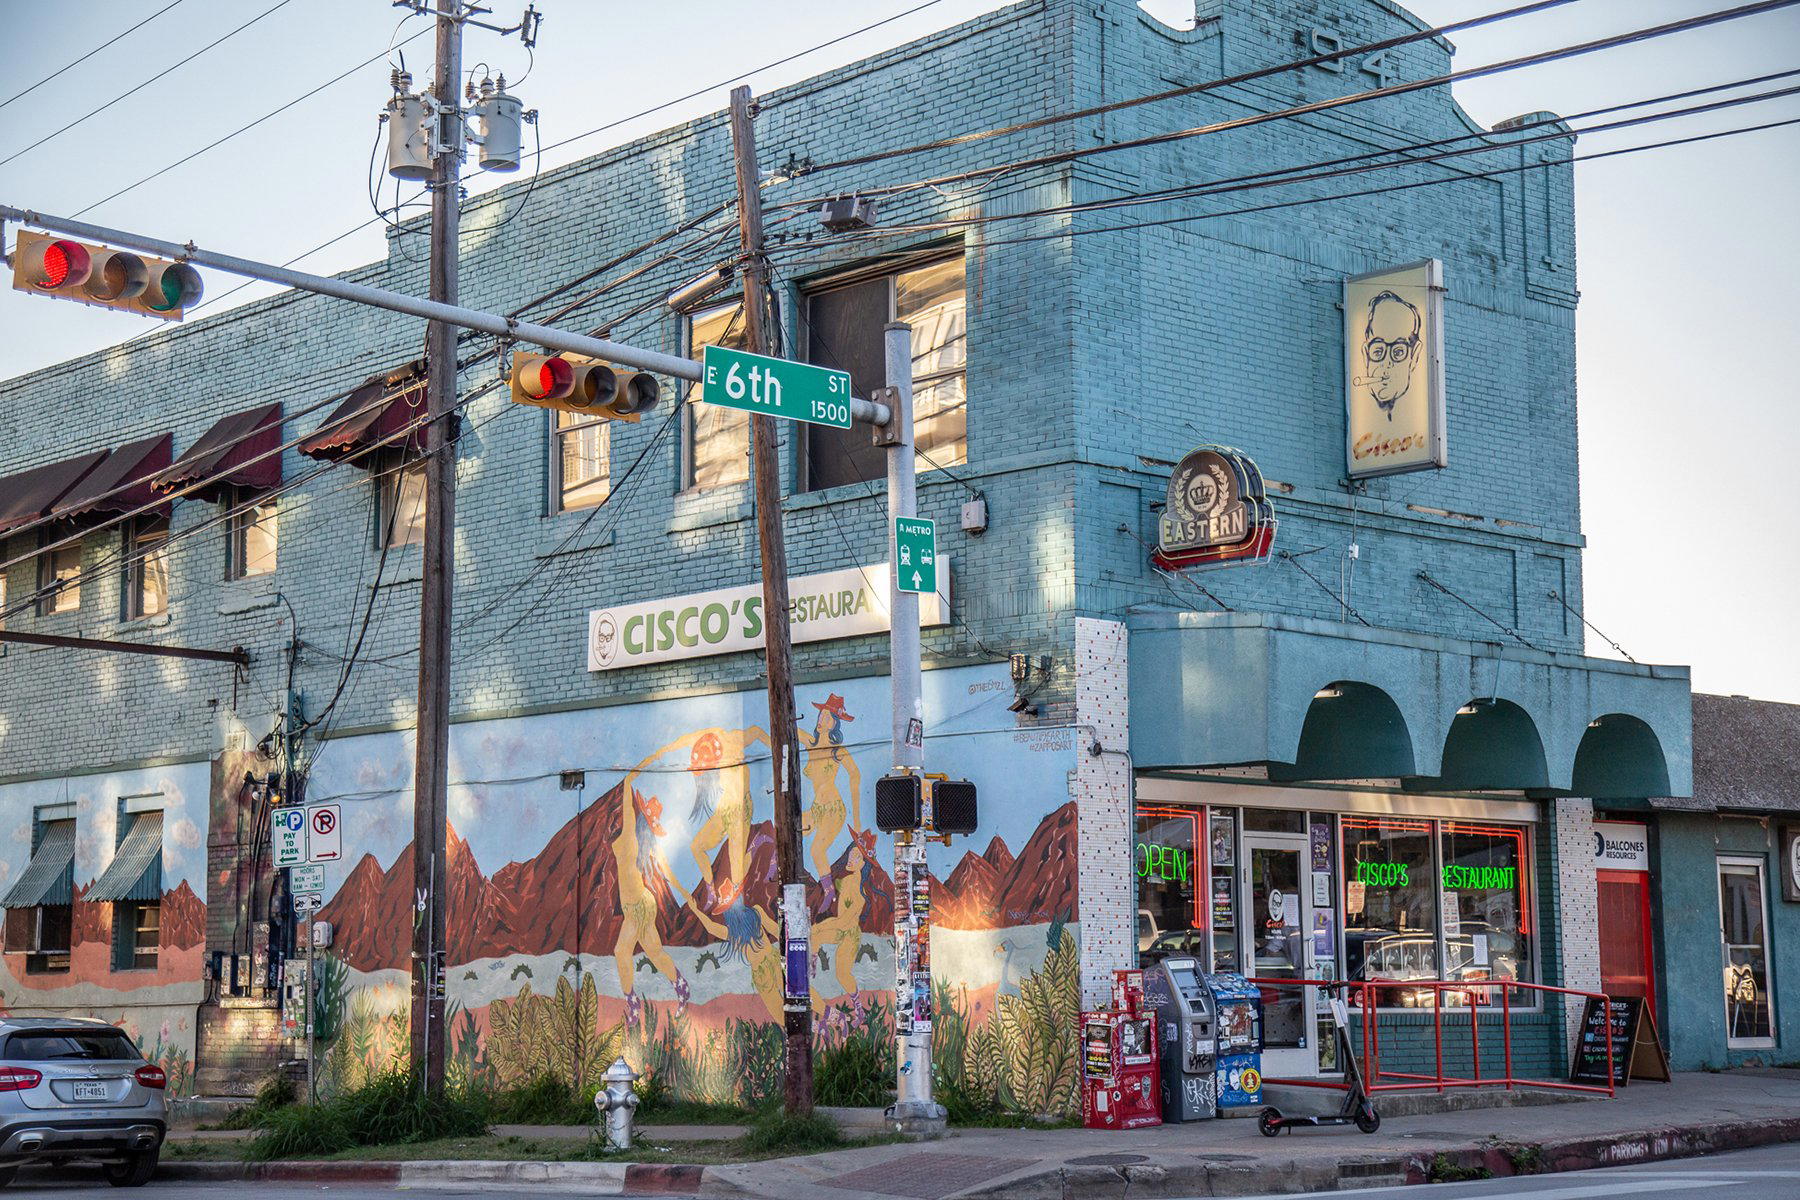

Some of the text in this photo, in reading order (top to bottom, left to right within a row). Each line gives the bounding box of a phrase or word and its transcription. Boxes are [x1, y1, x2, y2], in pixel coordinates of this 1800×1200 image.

[707, 361, 847, 407] E 6th ST
[811, 400, 848, 423] 1500
[905, 525, 931, 536] METRO
[1163, 508, 1244, 543] EASTERN
[623, 596, 763, 655] CISCO'S
[280, 848, 299, 856] PARK
[1605, 840, 1645, 852] BALCONES
[1606, 851, 1637, 860] RESOURCES
[1136, 842, 1187, 882] OPEN
[1357, 861, 1516, 890] CISCO'S RESTAURANT
